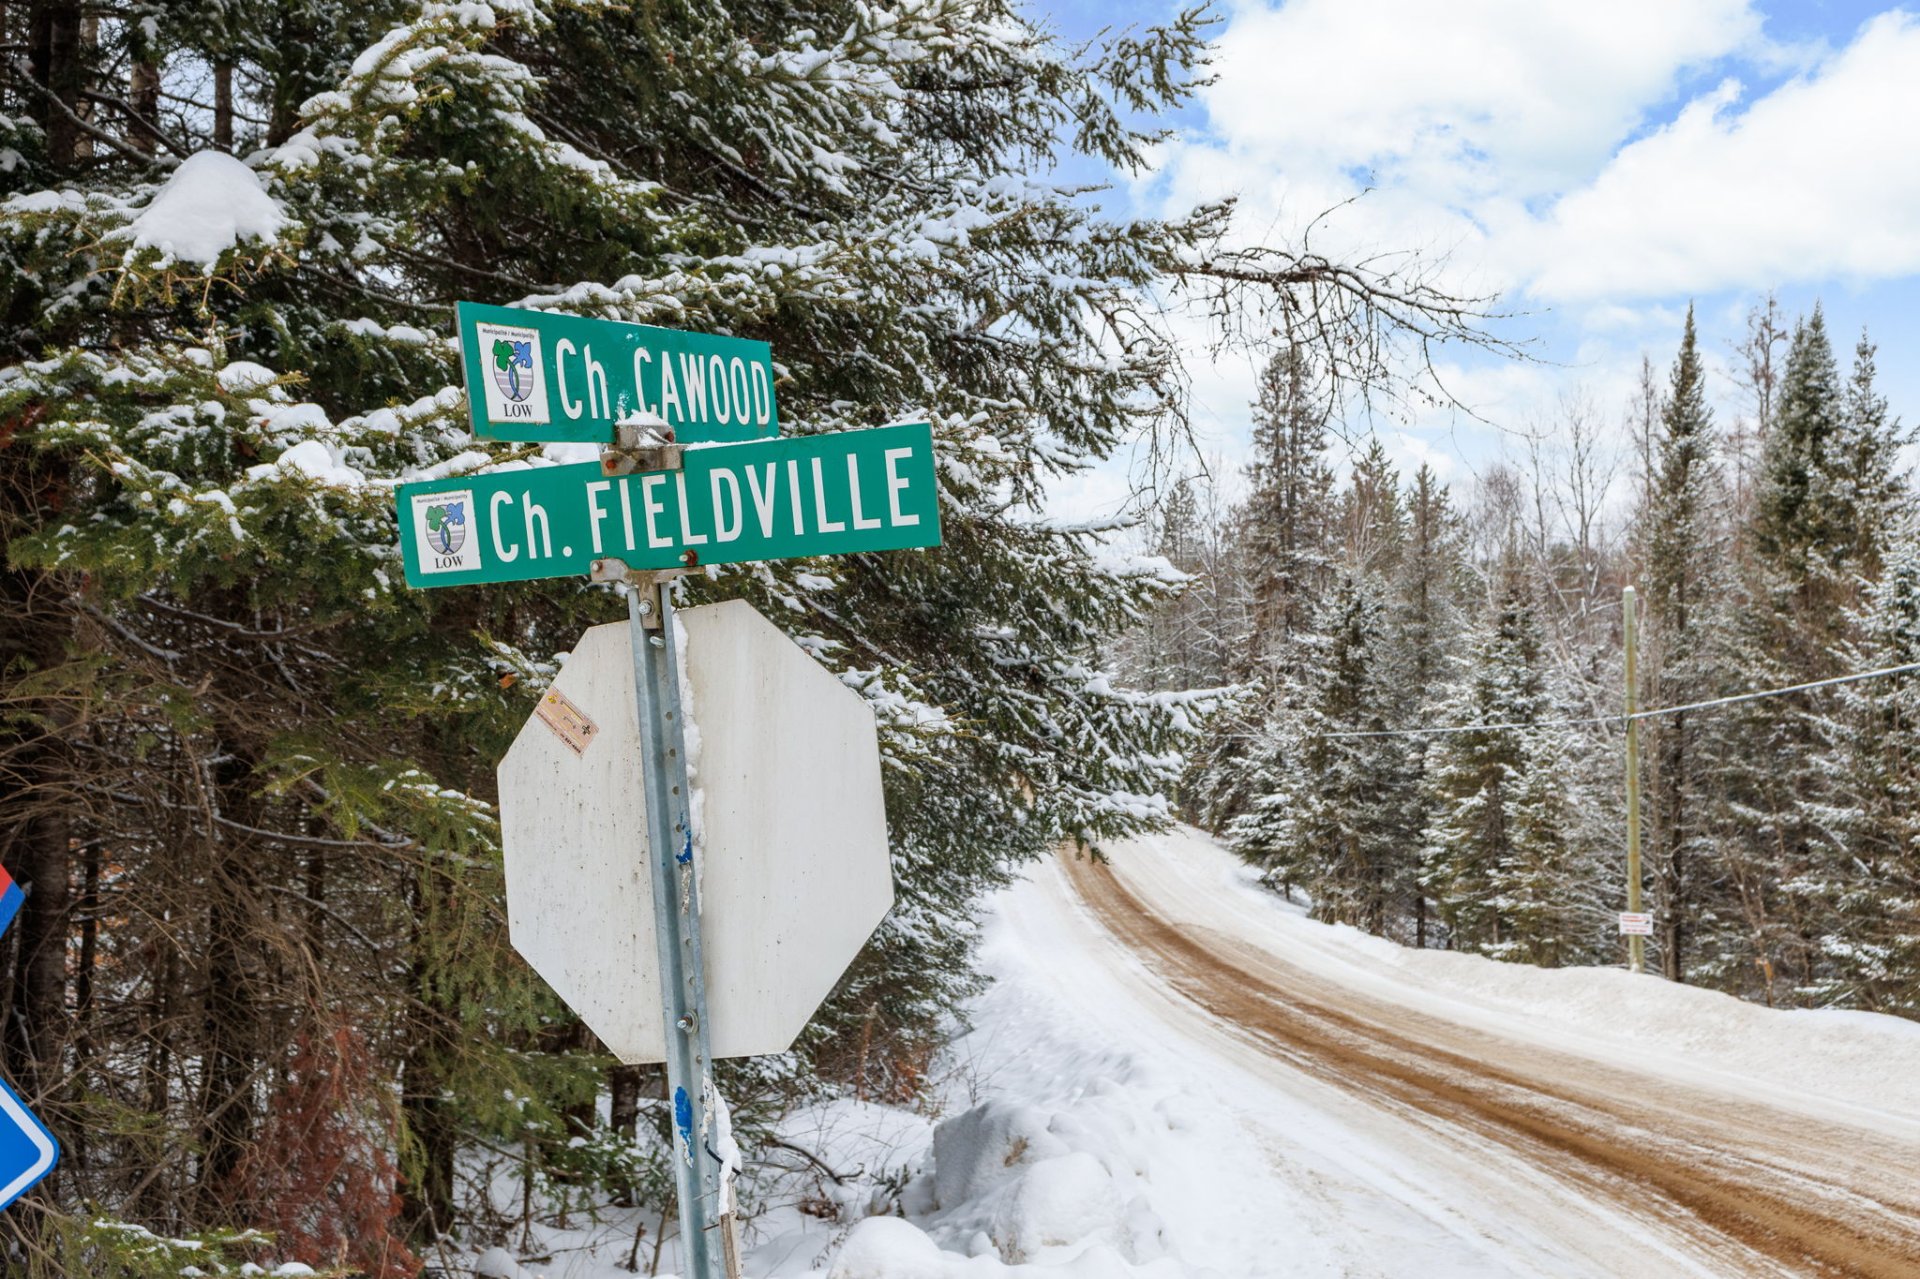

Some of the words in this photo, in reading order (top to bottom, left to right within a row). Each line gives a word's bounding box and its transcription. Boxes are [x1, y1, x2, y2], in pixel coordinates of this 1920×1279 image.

[633, 346, 770, 425] CAWOOD
[503, 404, 533, 418] LOW
[490, 489, 573, 562] Ch.
[586, 446, 920, 553] FIELDVILLE
[435, 555, 464, 569] LOW
